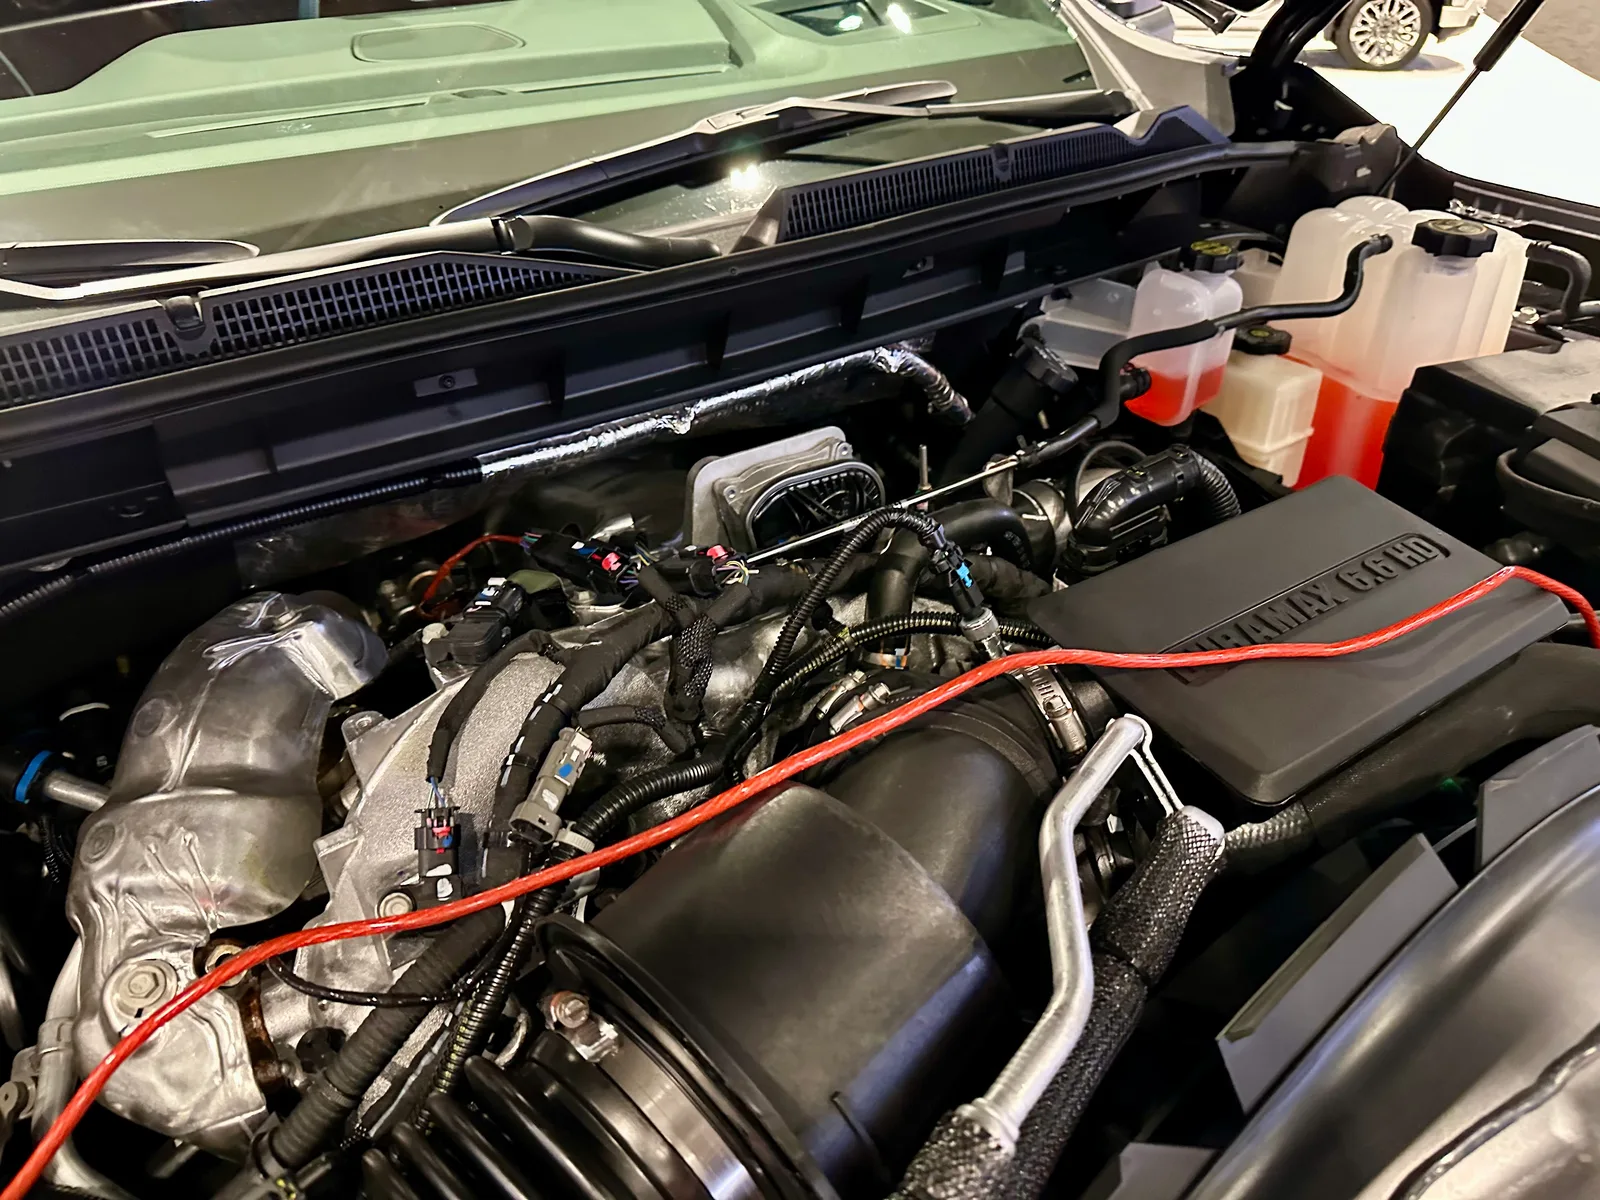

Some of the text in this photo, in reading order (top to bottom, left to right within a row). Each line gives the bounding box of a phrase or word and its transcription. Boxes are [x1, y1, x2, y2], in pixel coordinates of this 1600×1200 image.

[1163, 537, 1440, 686] RAMAX 6.6 HD
